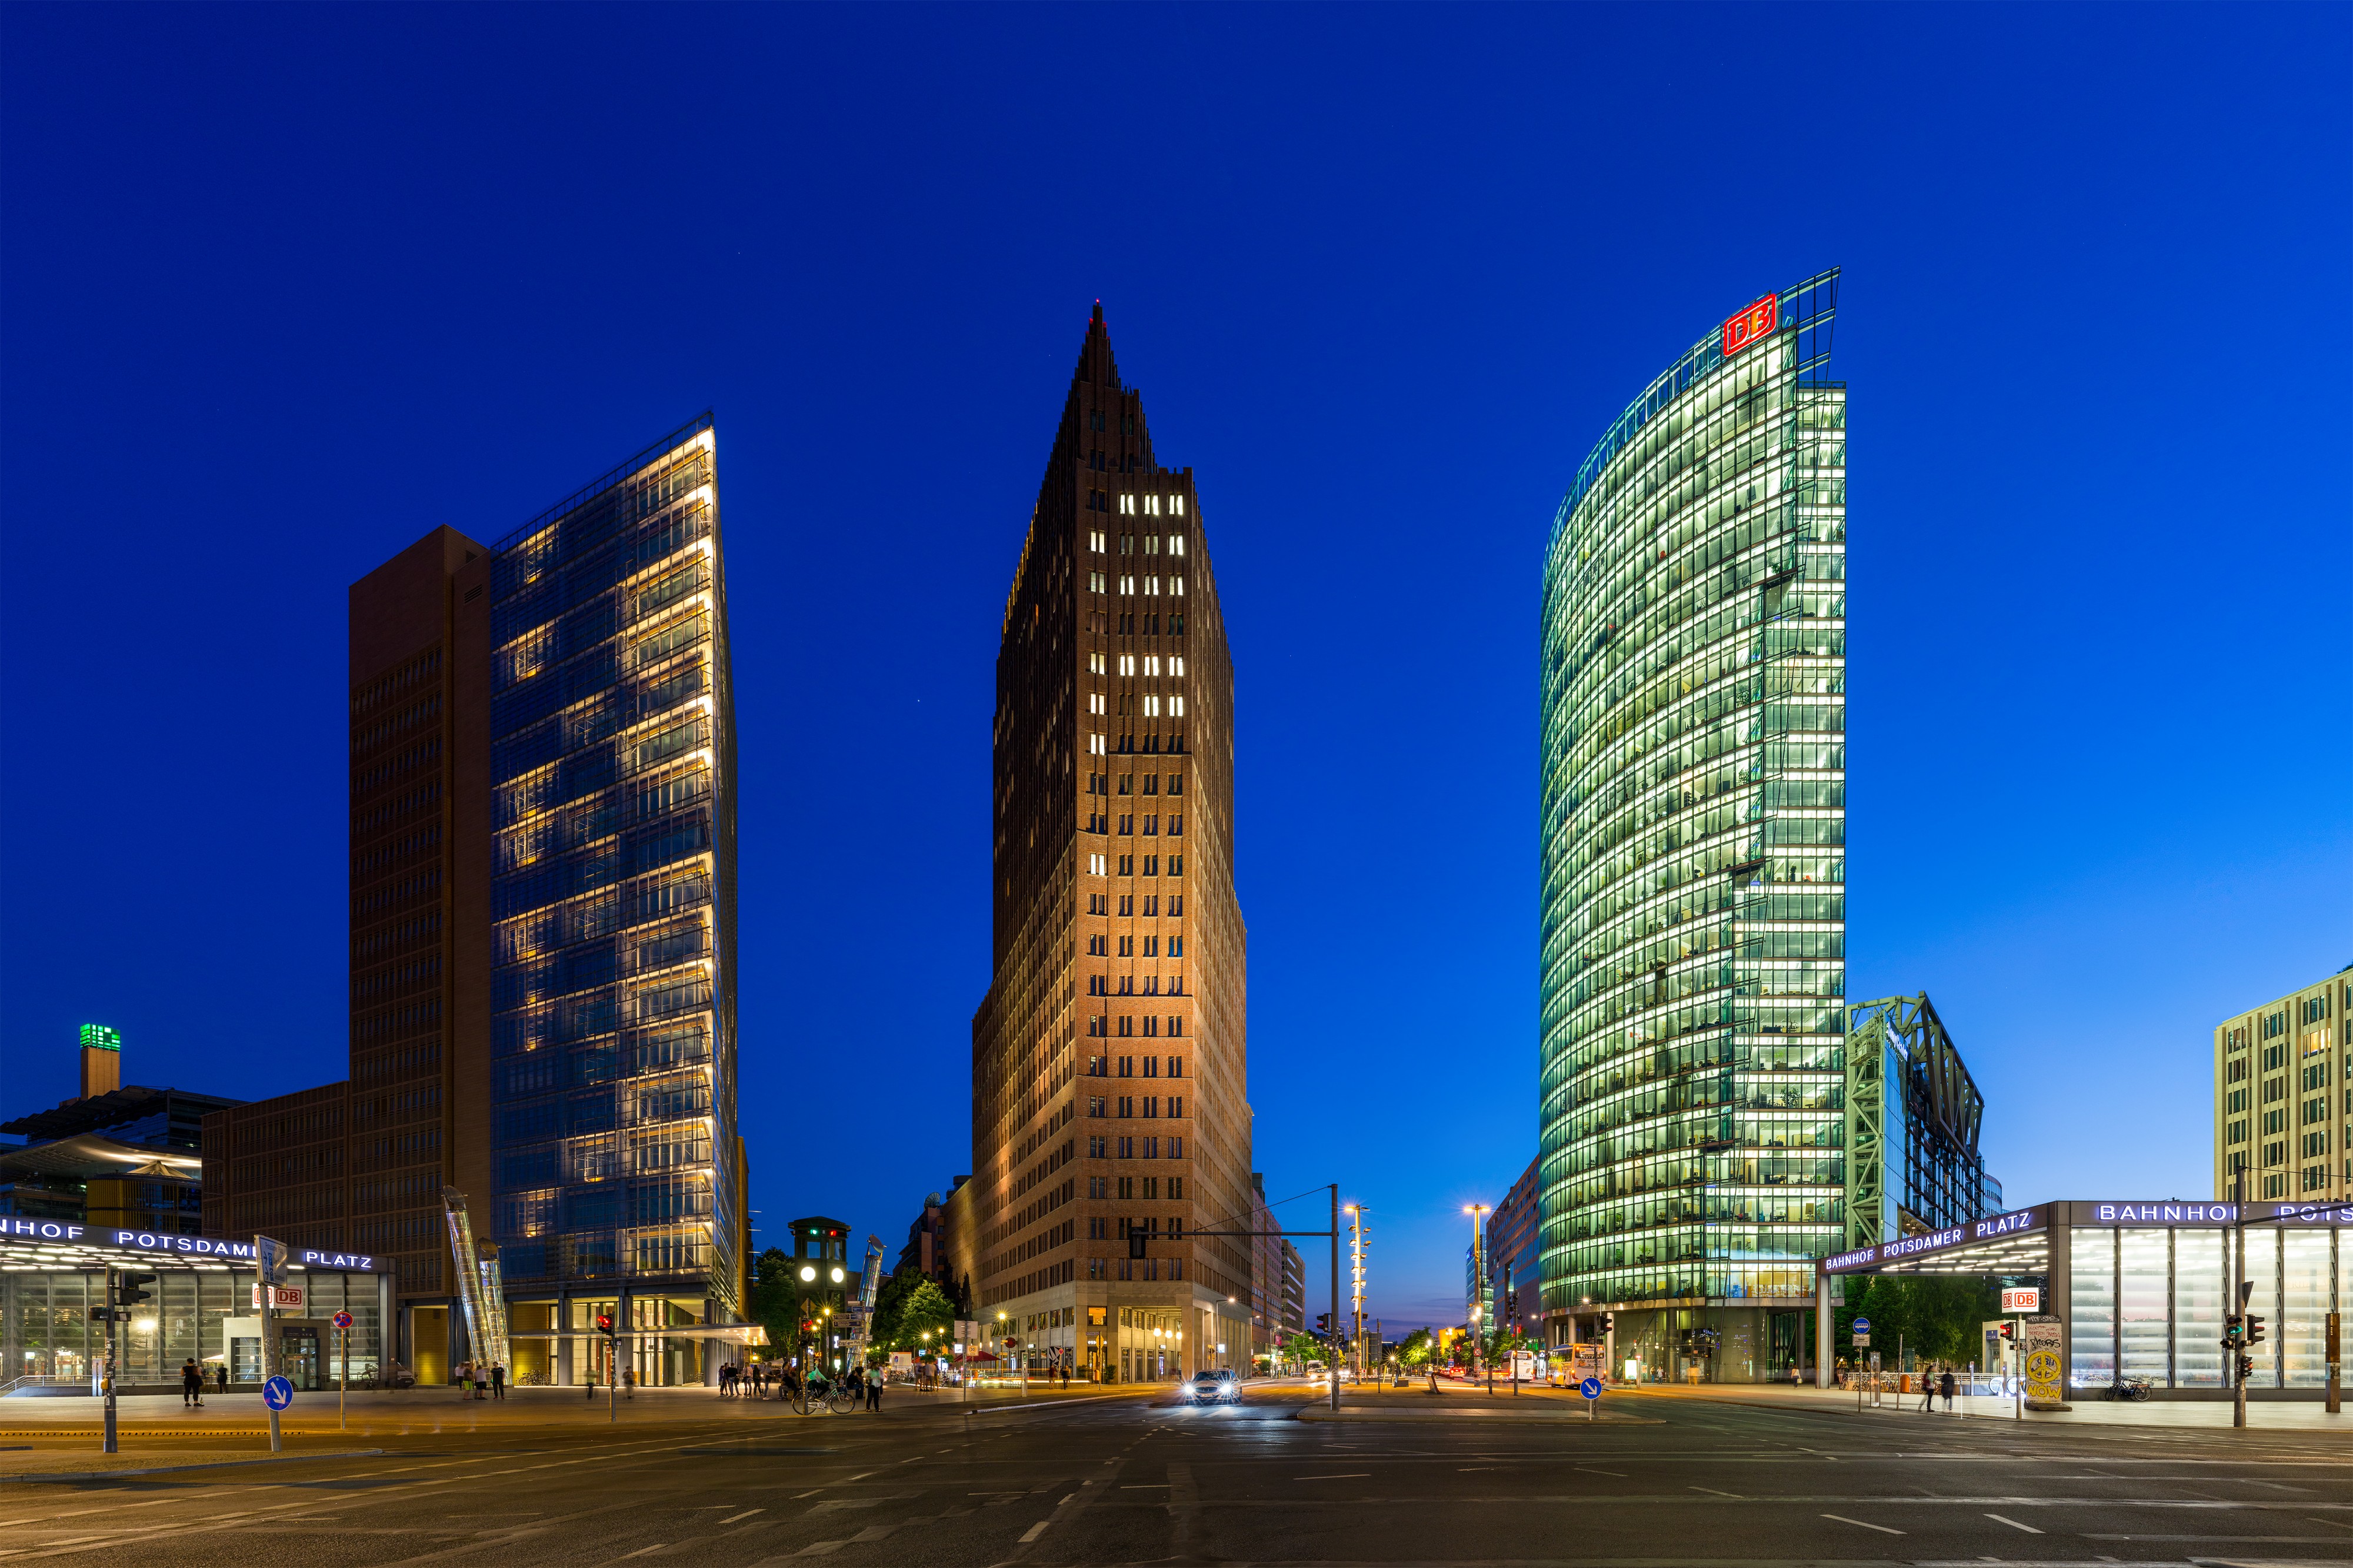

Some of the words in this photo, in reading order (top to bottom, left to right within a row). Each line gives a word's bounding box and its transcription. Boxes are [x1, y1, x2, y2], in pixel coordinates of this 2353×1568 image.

[1730, 303, 1771, 349] DB
[1826, 1249, 1874, 1269] BAHNHOF
[1884, 1229, 1962, 1257] POTSDAMER
[1977, 1212, 2029, 1237] PLATZ
[118, 1232, 257, 1257] POTSDAM
[306, 1252, 371, 1268] PLATZ
[279, 1290, 299, 1302] DB
[2004, 1295, 2011, 1306] DB
[2017, 1295, 2034, 1305] DB
[2027, 1384, 2061, 1399] NOW
